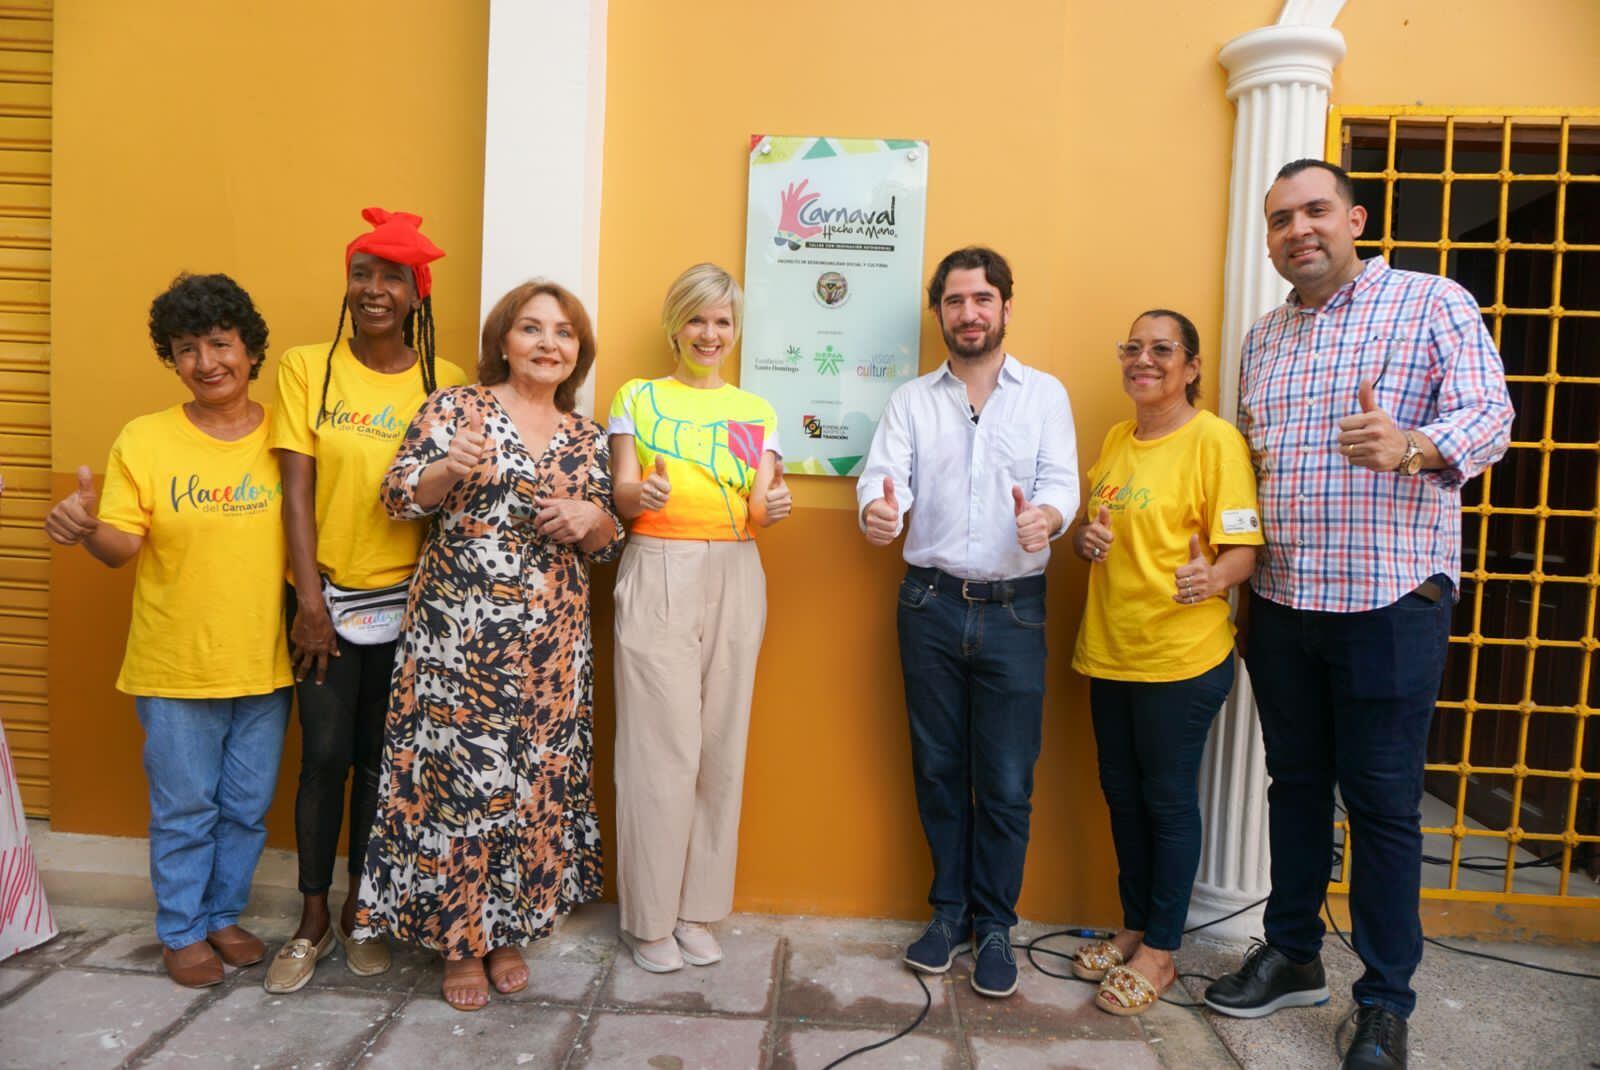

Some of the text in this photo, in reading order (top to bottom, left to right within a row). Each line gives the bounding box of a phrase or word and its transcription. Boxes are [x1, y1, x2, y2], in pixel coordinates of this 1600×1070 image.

[799, 195, 896, 226] Carnaval
[822, 224, 854, 241] Hecho
[856, 226, 864, 235] a
[856, 362, 896, 378] cultural
[356, 424, 402, 440] Carnaval
[222, 499, 268, 513] Carnaval
